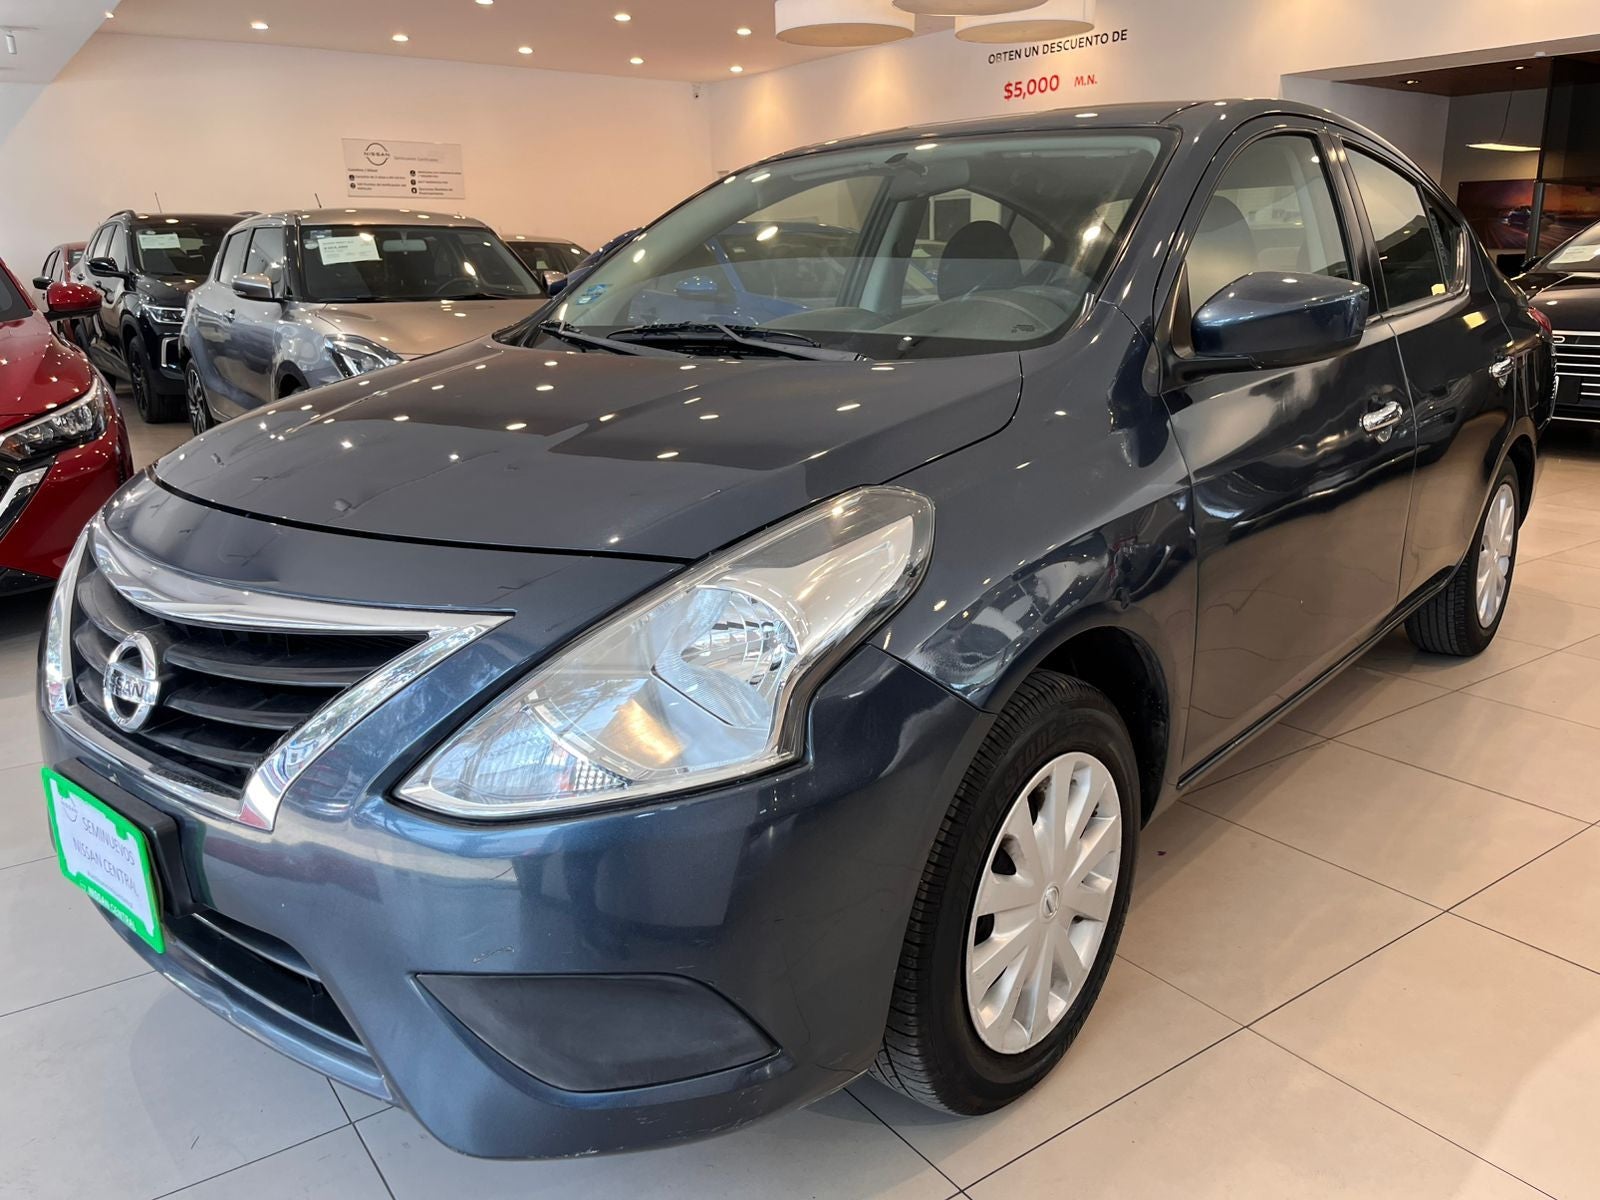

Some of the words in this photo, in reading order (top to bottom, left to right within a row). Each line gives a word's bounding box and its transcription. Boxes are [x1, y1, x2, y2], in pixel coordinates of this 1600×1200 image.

[988, 48, 1021, 64] OBTEN
[1024, 45, 1039, 58] UN
[1042, 33, 1109, 55] DESCUENTO
[1112, 29, 1128, 42] DE
[1004, 74, 1060, 101] $5,000
[1074, 74, 1098, 87] M.N.
[82, 816, 135, 866] SEMINUEVOS
[72, 835, 103, 868] NISSAN
[103, 858, 139, 897] CENTRAL
